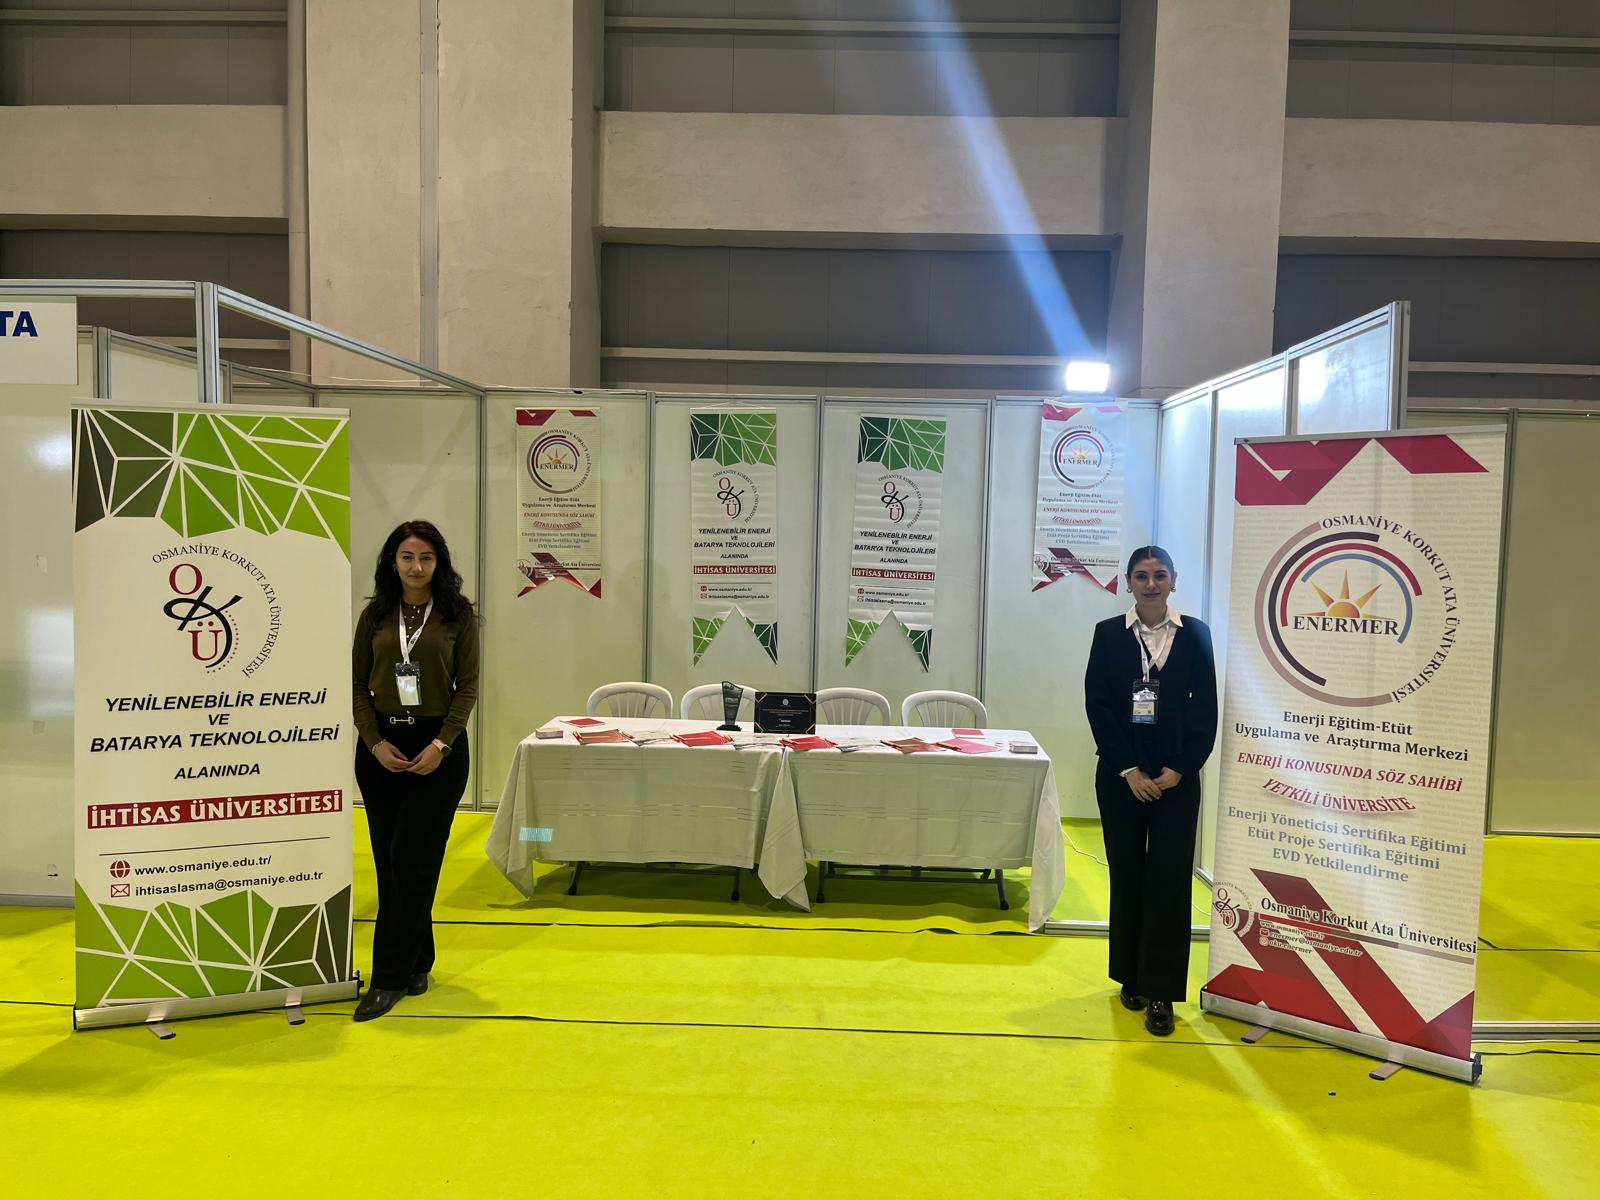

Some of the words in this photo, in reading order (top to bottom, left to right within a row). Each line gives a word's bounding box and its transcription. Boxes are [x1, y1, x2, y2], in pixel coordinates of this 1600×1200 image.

[860, 531, 908, 539] YENİLENEBİLİR
[1322, 515, 1403, 535] OSMANİYE
[152, 543, 220, 564] OSMANİYE
[885, 546, 936, 554] TEKNOLOJİLERİ
[1402, 530, 1452, 582] KORKUT
[222, 550, 266, 583] KORKUT
[261, 582, 276, 605] ATA
[1442, 583, 1457, 613] ATA
[1293, 616, 1399, 636] ENERMER
[241, 605, 282, 678] ÜNİVERSİTESİ
[1392, 616, 1460, 704] ÜNİVERSİTESİ
[106, 690, 254, 712] YENİLENEBİLİR
[259, 687, 328, 708] ENERJİ
[208, 714, 230, 726] VE
[1283, 711, 1325, 726] Enerji
[1328, 715, 1413, 736] Eğitim-Etüt
[90, 734, 182, 753] BATARYA
[190, 724, 340, 748] TEKNOLOJİLERİ
[1235, 723, 1300, 742] Uygulama
[1304, 732, 1320, 743] ve
[1326, 734, 1401, 754] Araştırma
[1405, 741, 1469, 762] Merkezi
[174, 764, 260, 780] ALANINDA
[1237, 752, 1284, 769] ENERJİ
[1285, 758, 1372, 780] KONUSUNDA
[1376, 768, 1406, 784] SÖZ
[1408, 773, 1463, 793] SAHİBİ
[91, 804, 181, 826] İHTİSAS
[190, 790, 340, 820] ÜNİVERSİTESİ
[1262, 778, 1320, 806] YETKİLİ
[1322, 792, 1416, 812] ÜNİVERSİTE
[1228, 806, 1268, 823] Enerji
[1271, 812, 1338, 834] Yöneticisi
[1342, 824, 1406, 845] Sertifika
[1411, 836, 1467, 856] Eğitimi
[1248, 826, 1276, 840] Etüt
[1278, 832, 1316, 848] Proje
[1318, 838, 1381, 860] Sertifika
[1385, 850, 1440, 870] Eğitimi
[134, 856, 272, 876] www.osmaniye.edu.tr/
[1272, 848, 1300, 862] EVD
[1304, 853, 1409, 882] Yetkilendirme
[135, 870, 324, 897] ihtisaslasma@osmaniye.edu.tr
[1261, 897, 1320, 922] Osmaniye
[1322, 910, 1368, 931] Korkut
[1371, 920, 1394, 937] Ata
[1398, 922, 1477, 954] Üniversitesi
